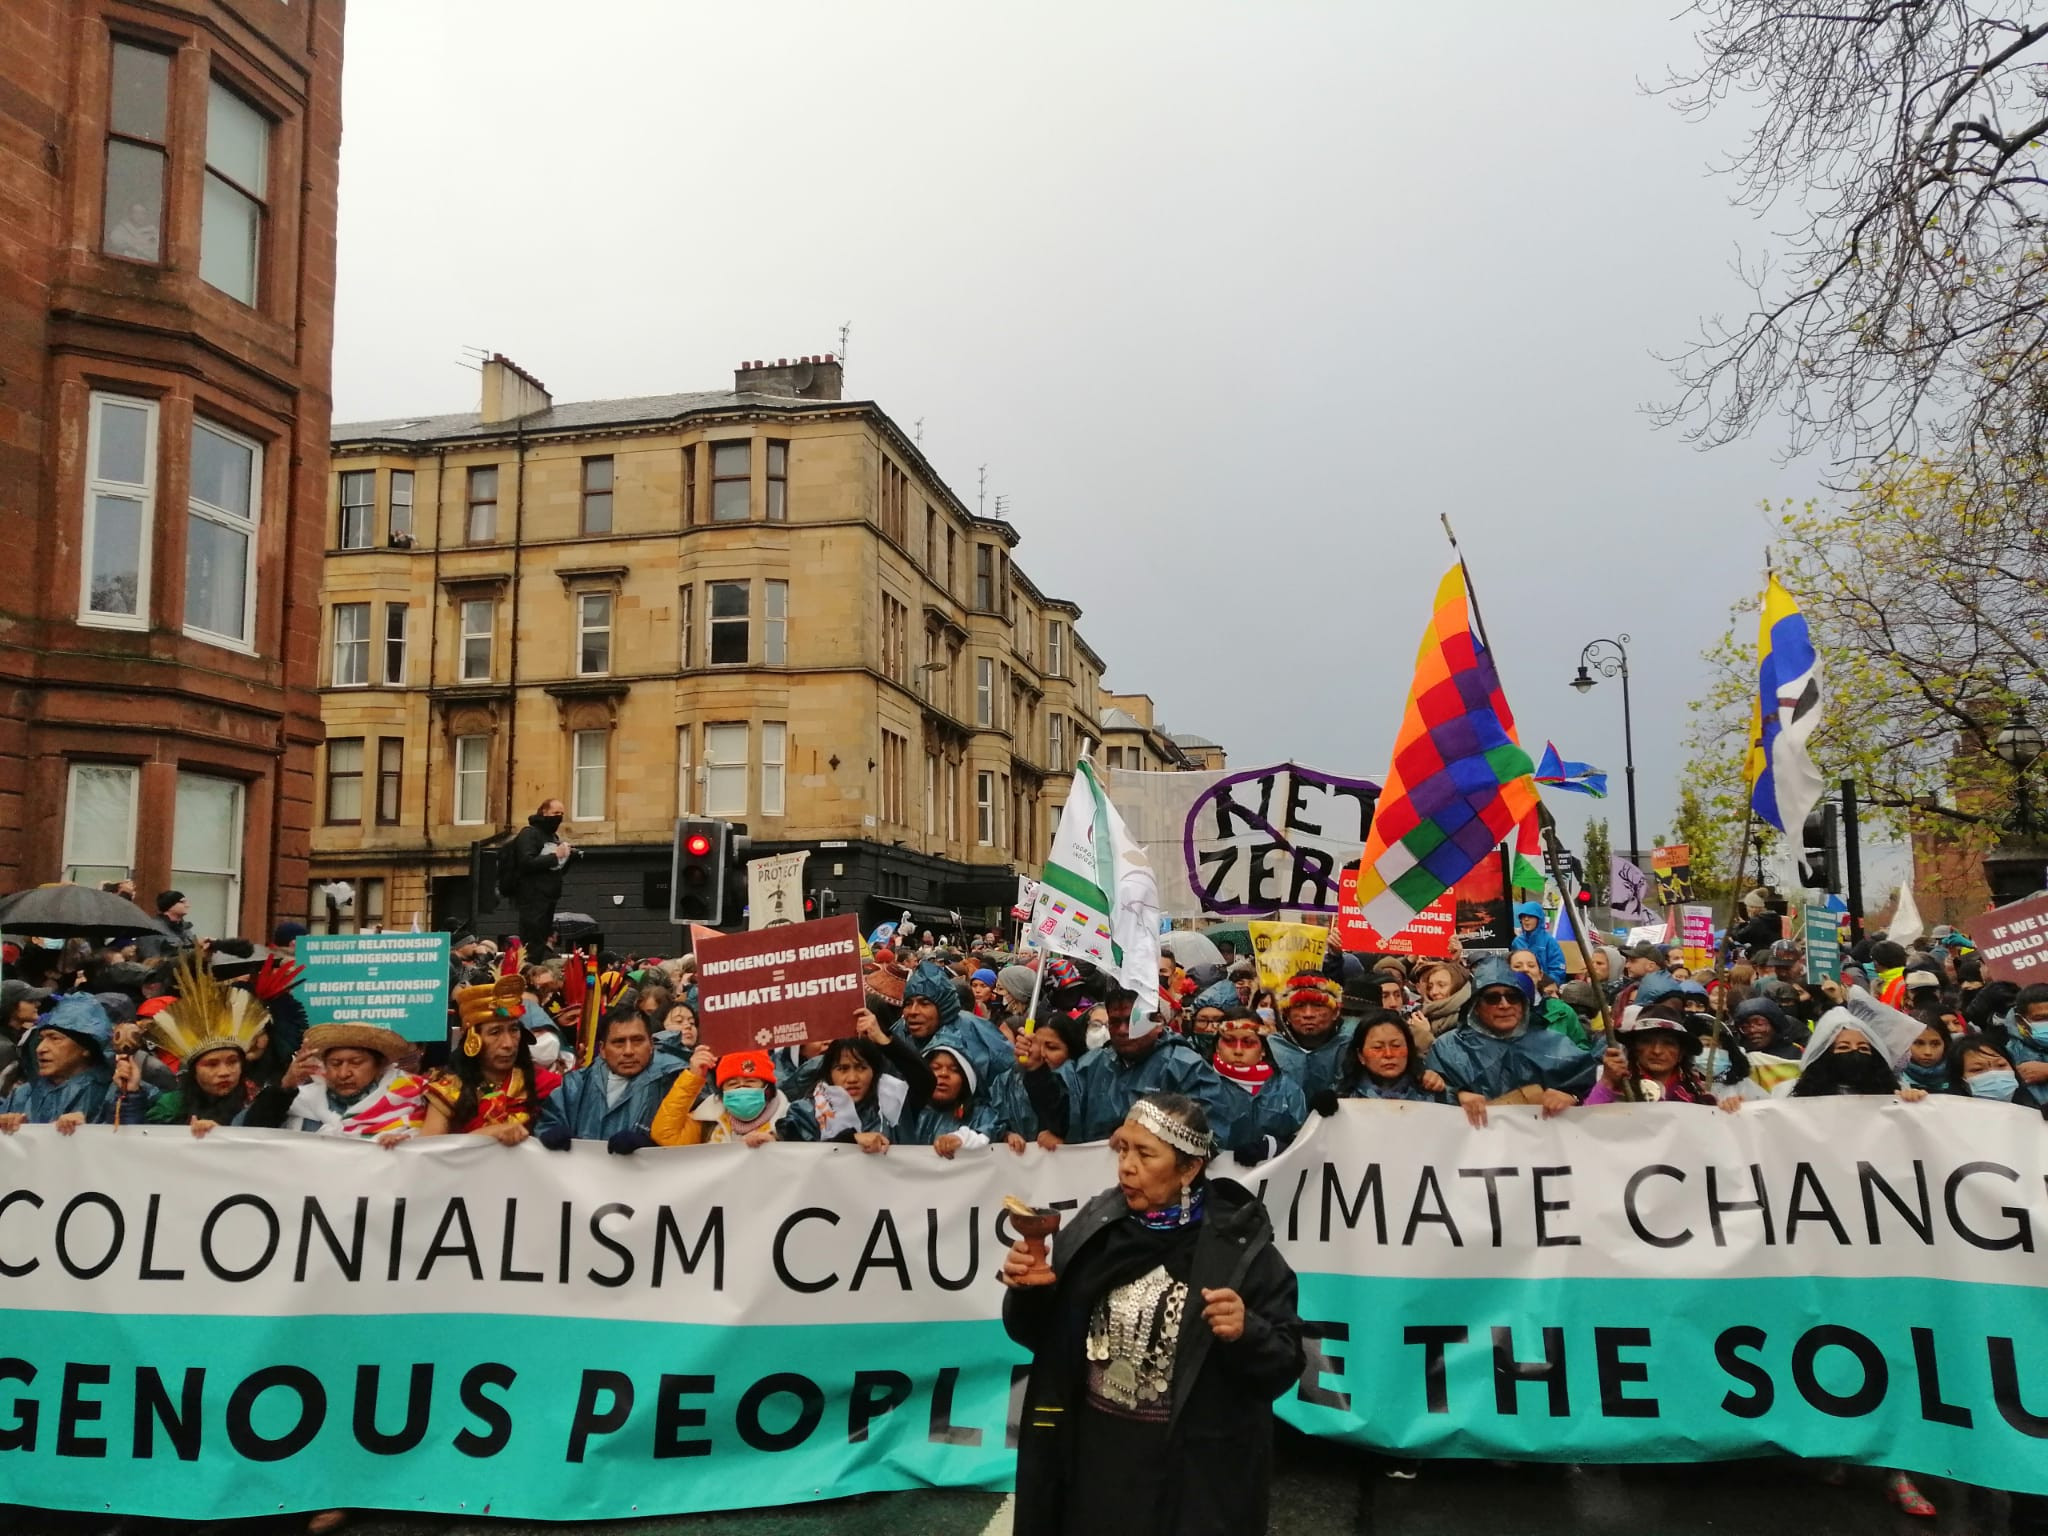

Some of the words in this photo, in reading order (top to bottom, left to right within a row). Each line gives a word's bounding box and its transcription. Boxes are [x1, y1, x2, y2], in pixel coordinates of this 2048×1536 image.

[1216, 774, 1382, 843] NET
[758, 864, 799, 882] PROTECT
[1200, 841, 1361, 912] ZER
[1347, 920, 1369, 929] ARE
[1992, 926, 2008, 940] IF
[2009, 917, 2038, 935] WE
[306, 941, 319, 951] IN
[321, 940, 357, 951] RIGHT
[358, 937, 443, 951] RELATIONSHIP
[1983, 934, 2044, 960] WORLD
[309, 954, 341, 965] WITH
[342, 952, 415, 964] INDIGENOUS
[416, 951, 438, 962] KIN
[702, 949, 797, 977] INDIGENOUS
[799, 939, 854, 961] RIGHTS
[2012, 954, 2037, 970] SO
[304, 982, 319, 993] IN
[319, 981, 355, 992] RIGHT
[356, 979, 441, 991] RELATIONSHIP
[704, 985, 782, 1012] CLIMATE
[784, 973, 859, 1000] JUSTICE
[309, 995, 341, 1006] WITH
[342, 995, 366, 1006] THE
[367, 994, 406, 1005] EARTH
[406, 993, 434, 1004] AND
[333, 1009, 359, 1020] OUR
[361, 1008, 409, 1019] FUTURE.
[773, 1021, 807, 1036] MINGA
[0, 1189, 724, 1290] COLONIALISM
[1625, 1159, 2048, 1253] CHANG
[1404, 1325, 1660, 1418] THE
